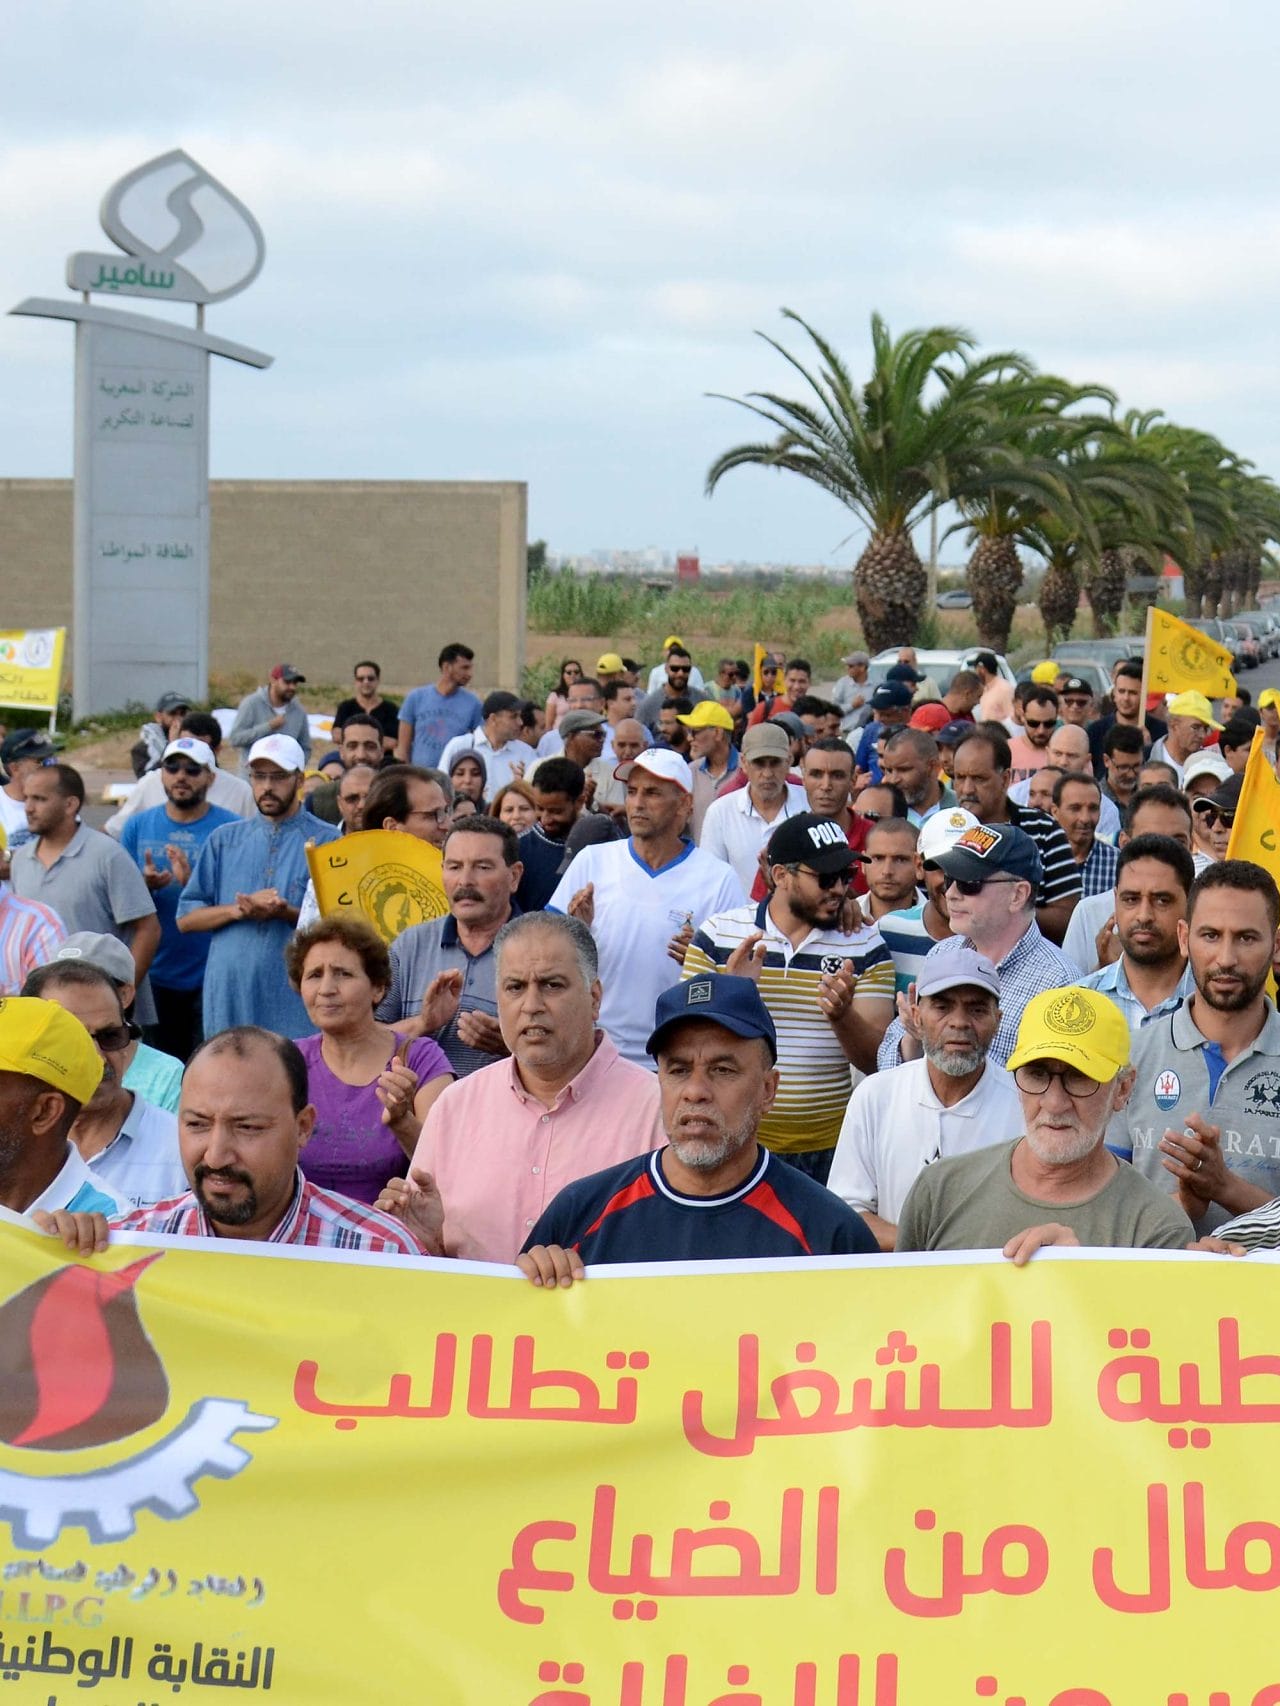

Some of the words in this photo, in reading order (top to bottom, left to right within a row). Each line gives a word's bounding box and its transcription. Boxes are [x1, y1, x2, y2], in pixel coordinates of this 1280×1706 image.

[90, 263, 174, 290] سامير
[293, 1332, 650, 1431] تطالب
[682, 1320, 1053, 1458] للشغل
[497, 1484, 839, 1625] الضياع
[884, 1509, 1049, 1618] من
[0, 1630, 134, 1688] الوطني
[147, 1642, 275, 1693] النقابة
